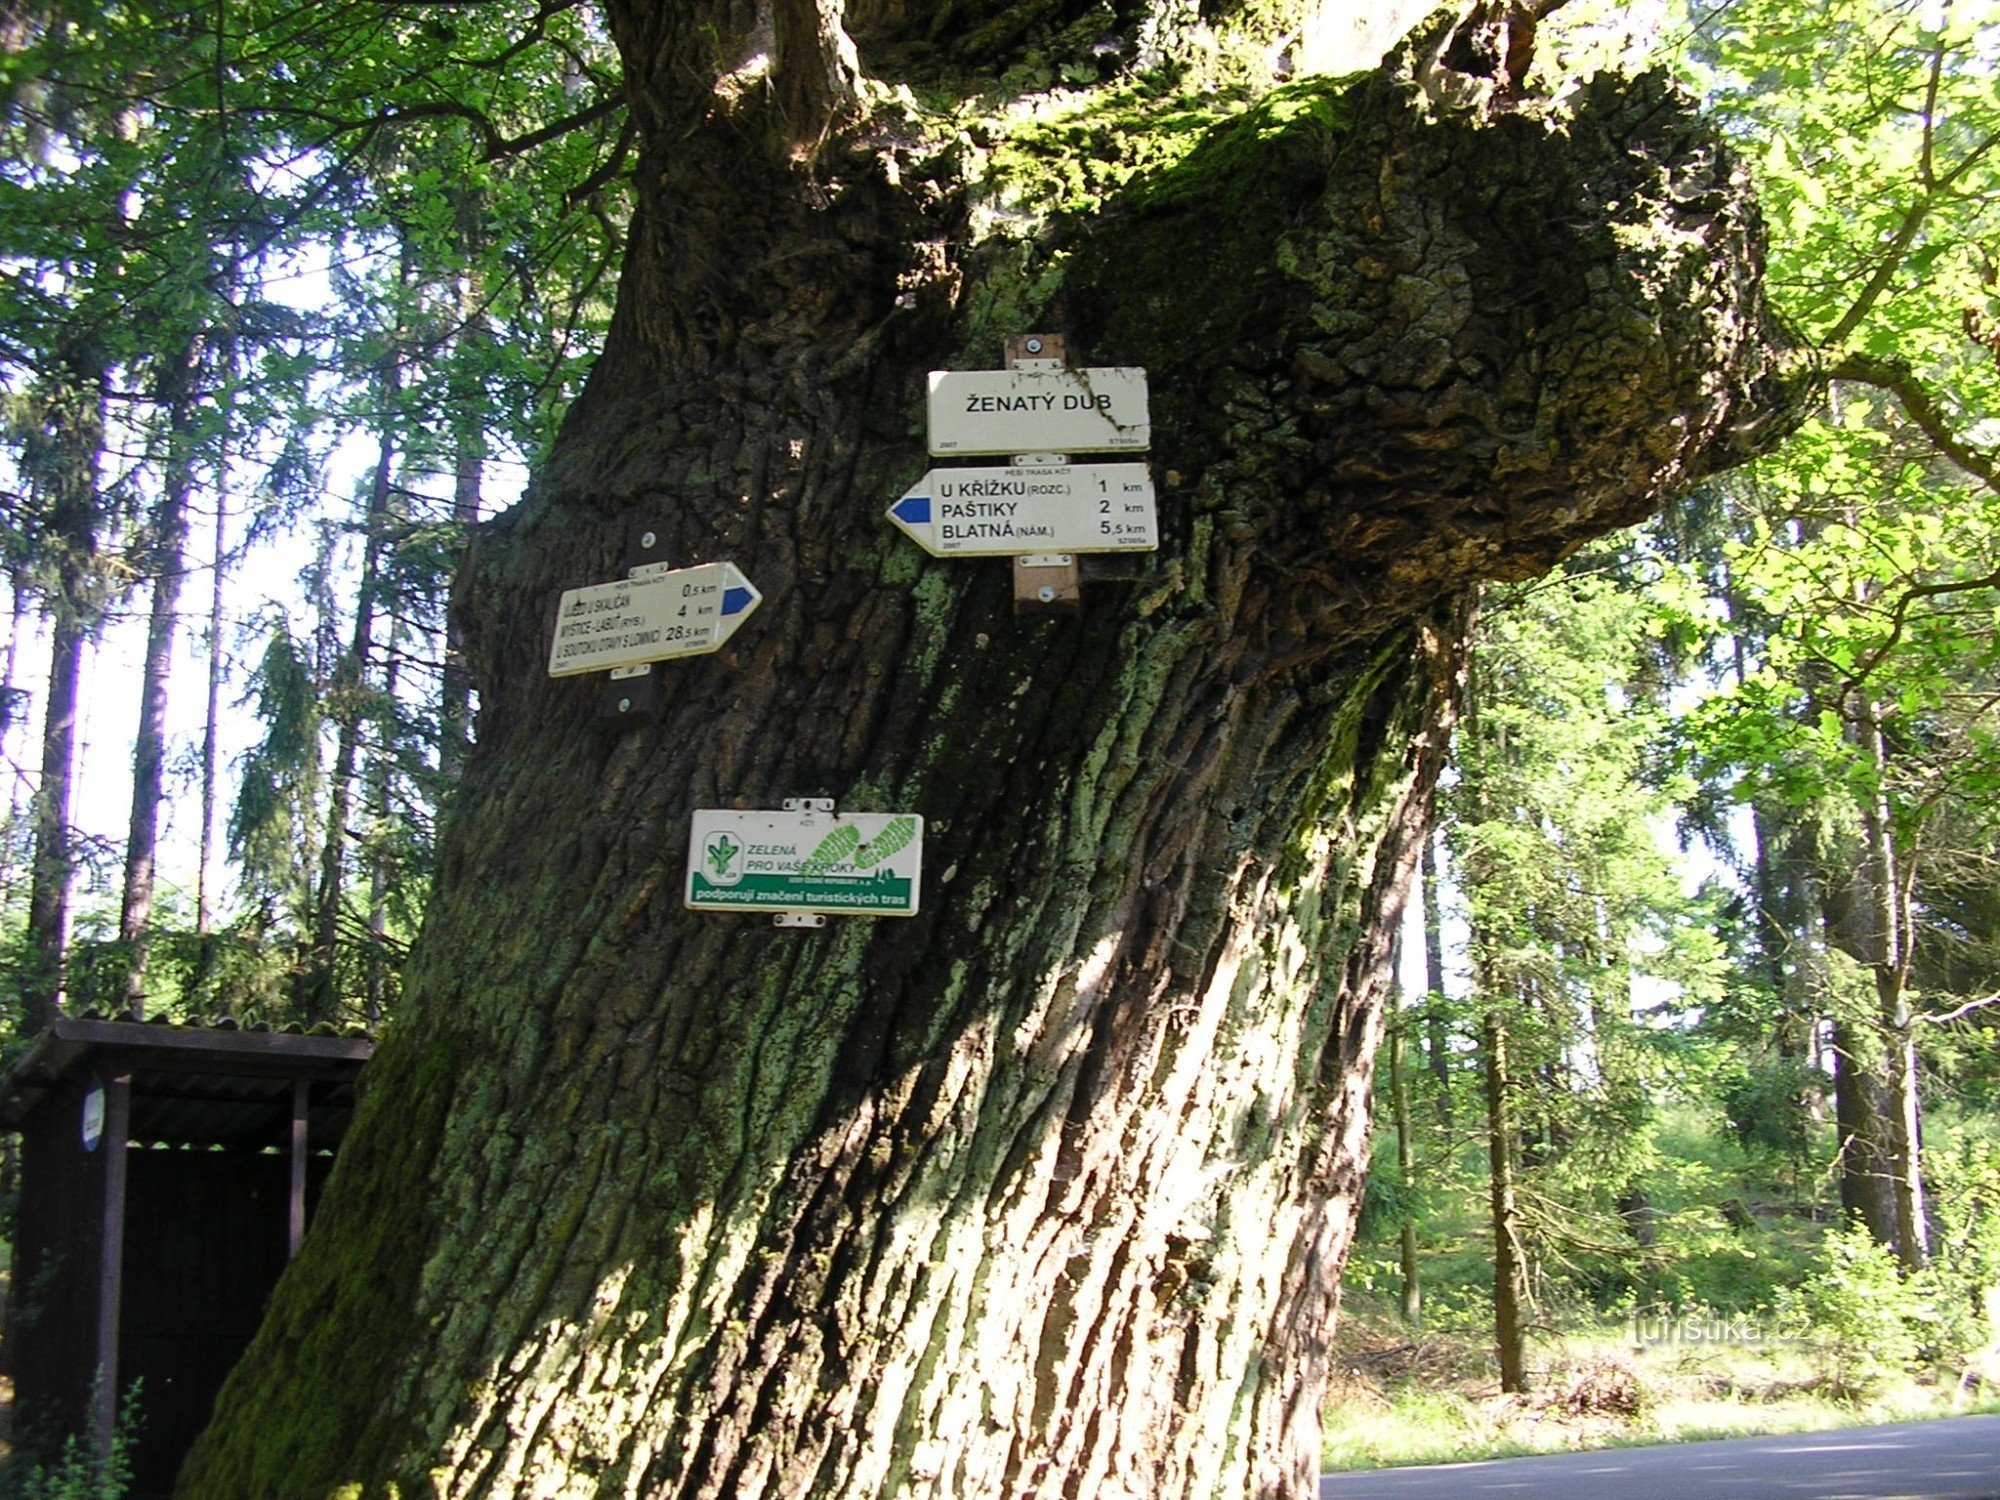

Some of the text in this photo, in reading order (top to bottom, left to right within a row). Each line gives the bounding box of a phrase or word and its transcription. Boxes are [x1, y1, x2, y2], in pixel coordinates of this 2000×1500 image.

[966, 392, 1112, 412] ŽENATÝ DUB
[941, 484, 953, 498] U
[960, 479, 1025, 497] KŘÍŽKU
[1099, 479, 1107, 493] 1
[1123, 483, 1142, 492] km
[942, 500, 1144, 518] PAŠTIKY 2 km
[943, 519, 1015, 539] BLATNÁ
[1126, 524, 1146, 533] km
[677, 604, 687, 617] 4
[747, 843, 797, 856] ZELENÁ
[746, 860, 773, 871] PRO
[777, 858, 810, 872] VAŠE
[881, 895, 906, 905] tras
